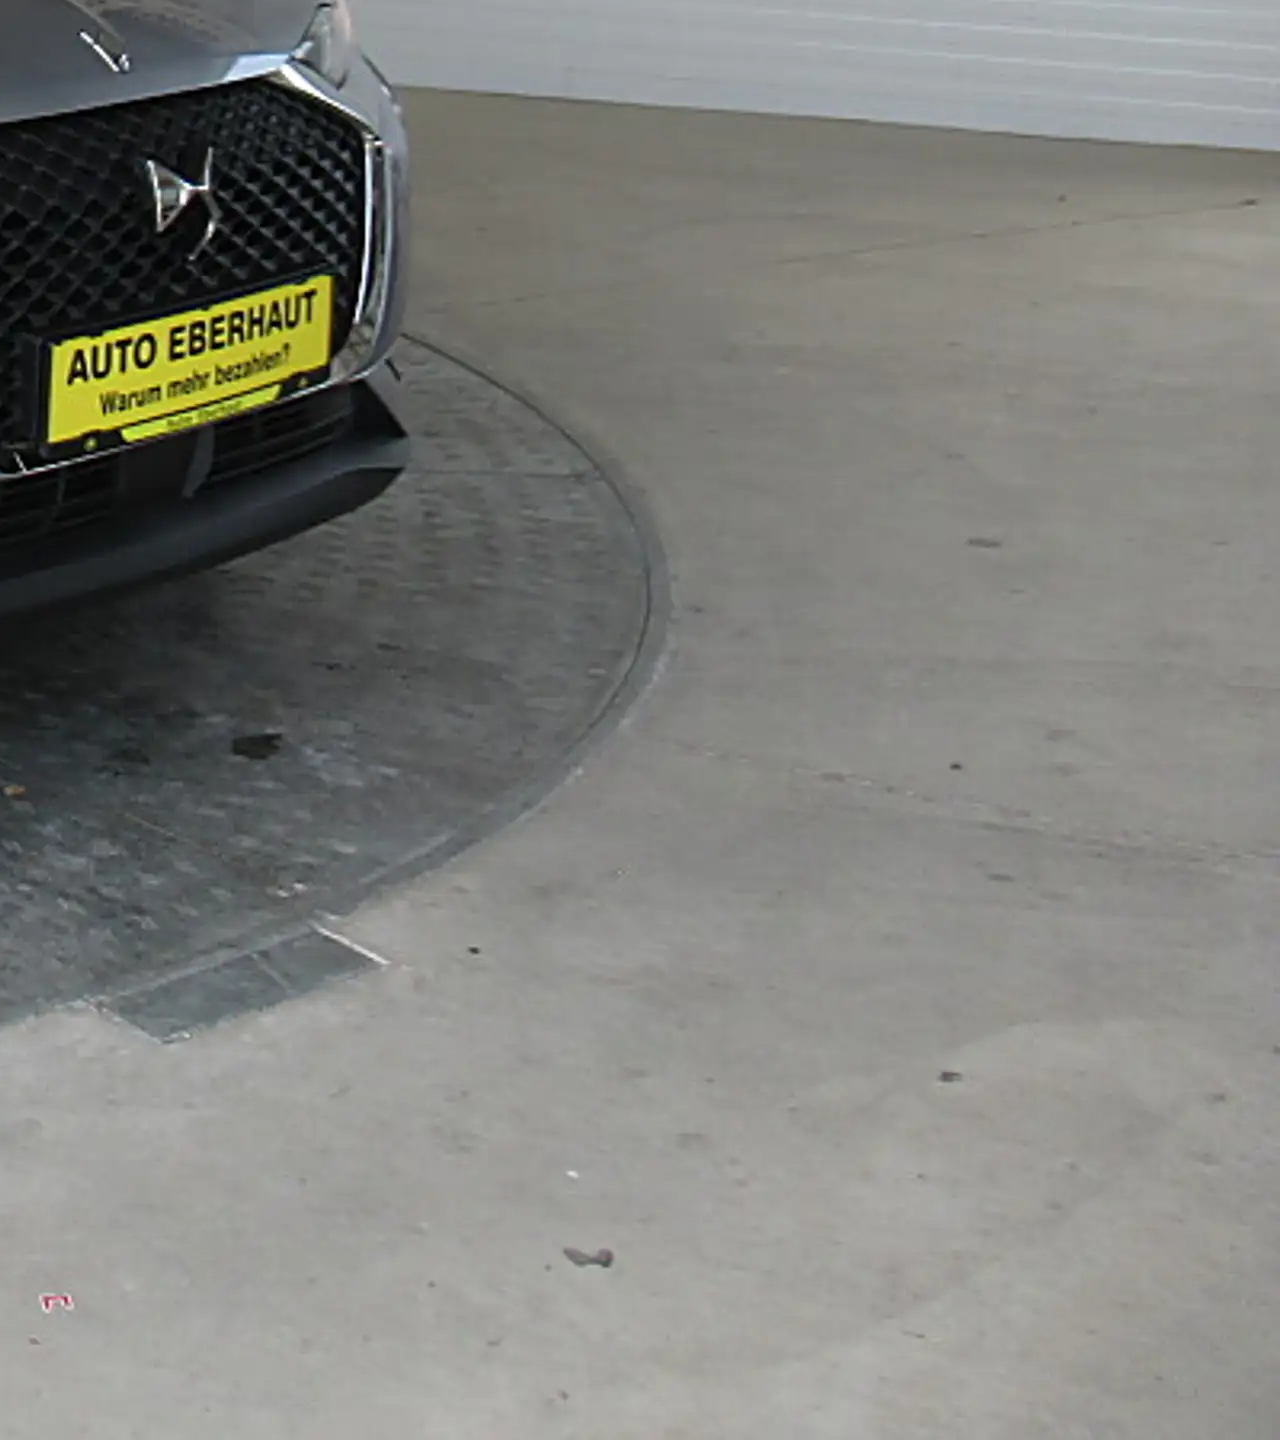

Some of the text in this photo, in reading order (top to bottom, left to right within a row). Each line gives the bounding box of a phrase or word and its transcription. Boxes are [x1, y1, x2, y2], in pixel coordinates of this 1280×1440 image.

[67, 289, 317, 385] AUTO EBERHAUT
[99, 343, 291, 415] Warum mehr bezahlen?
